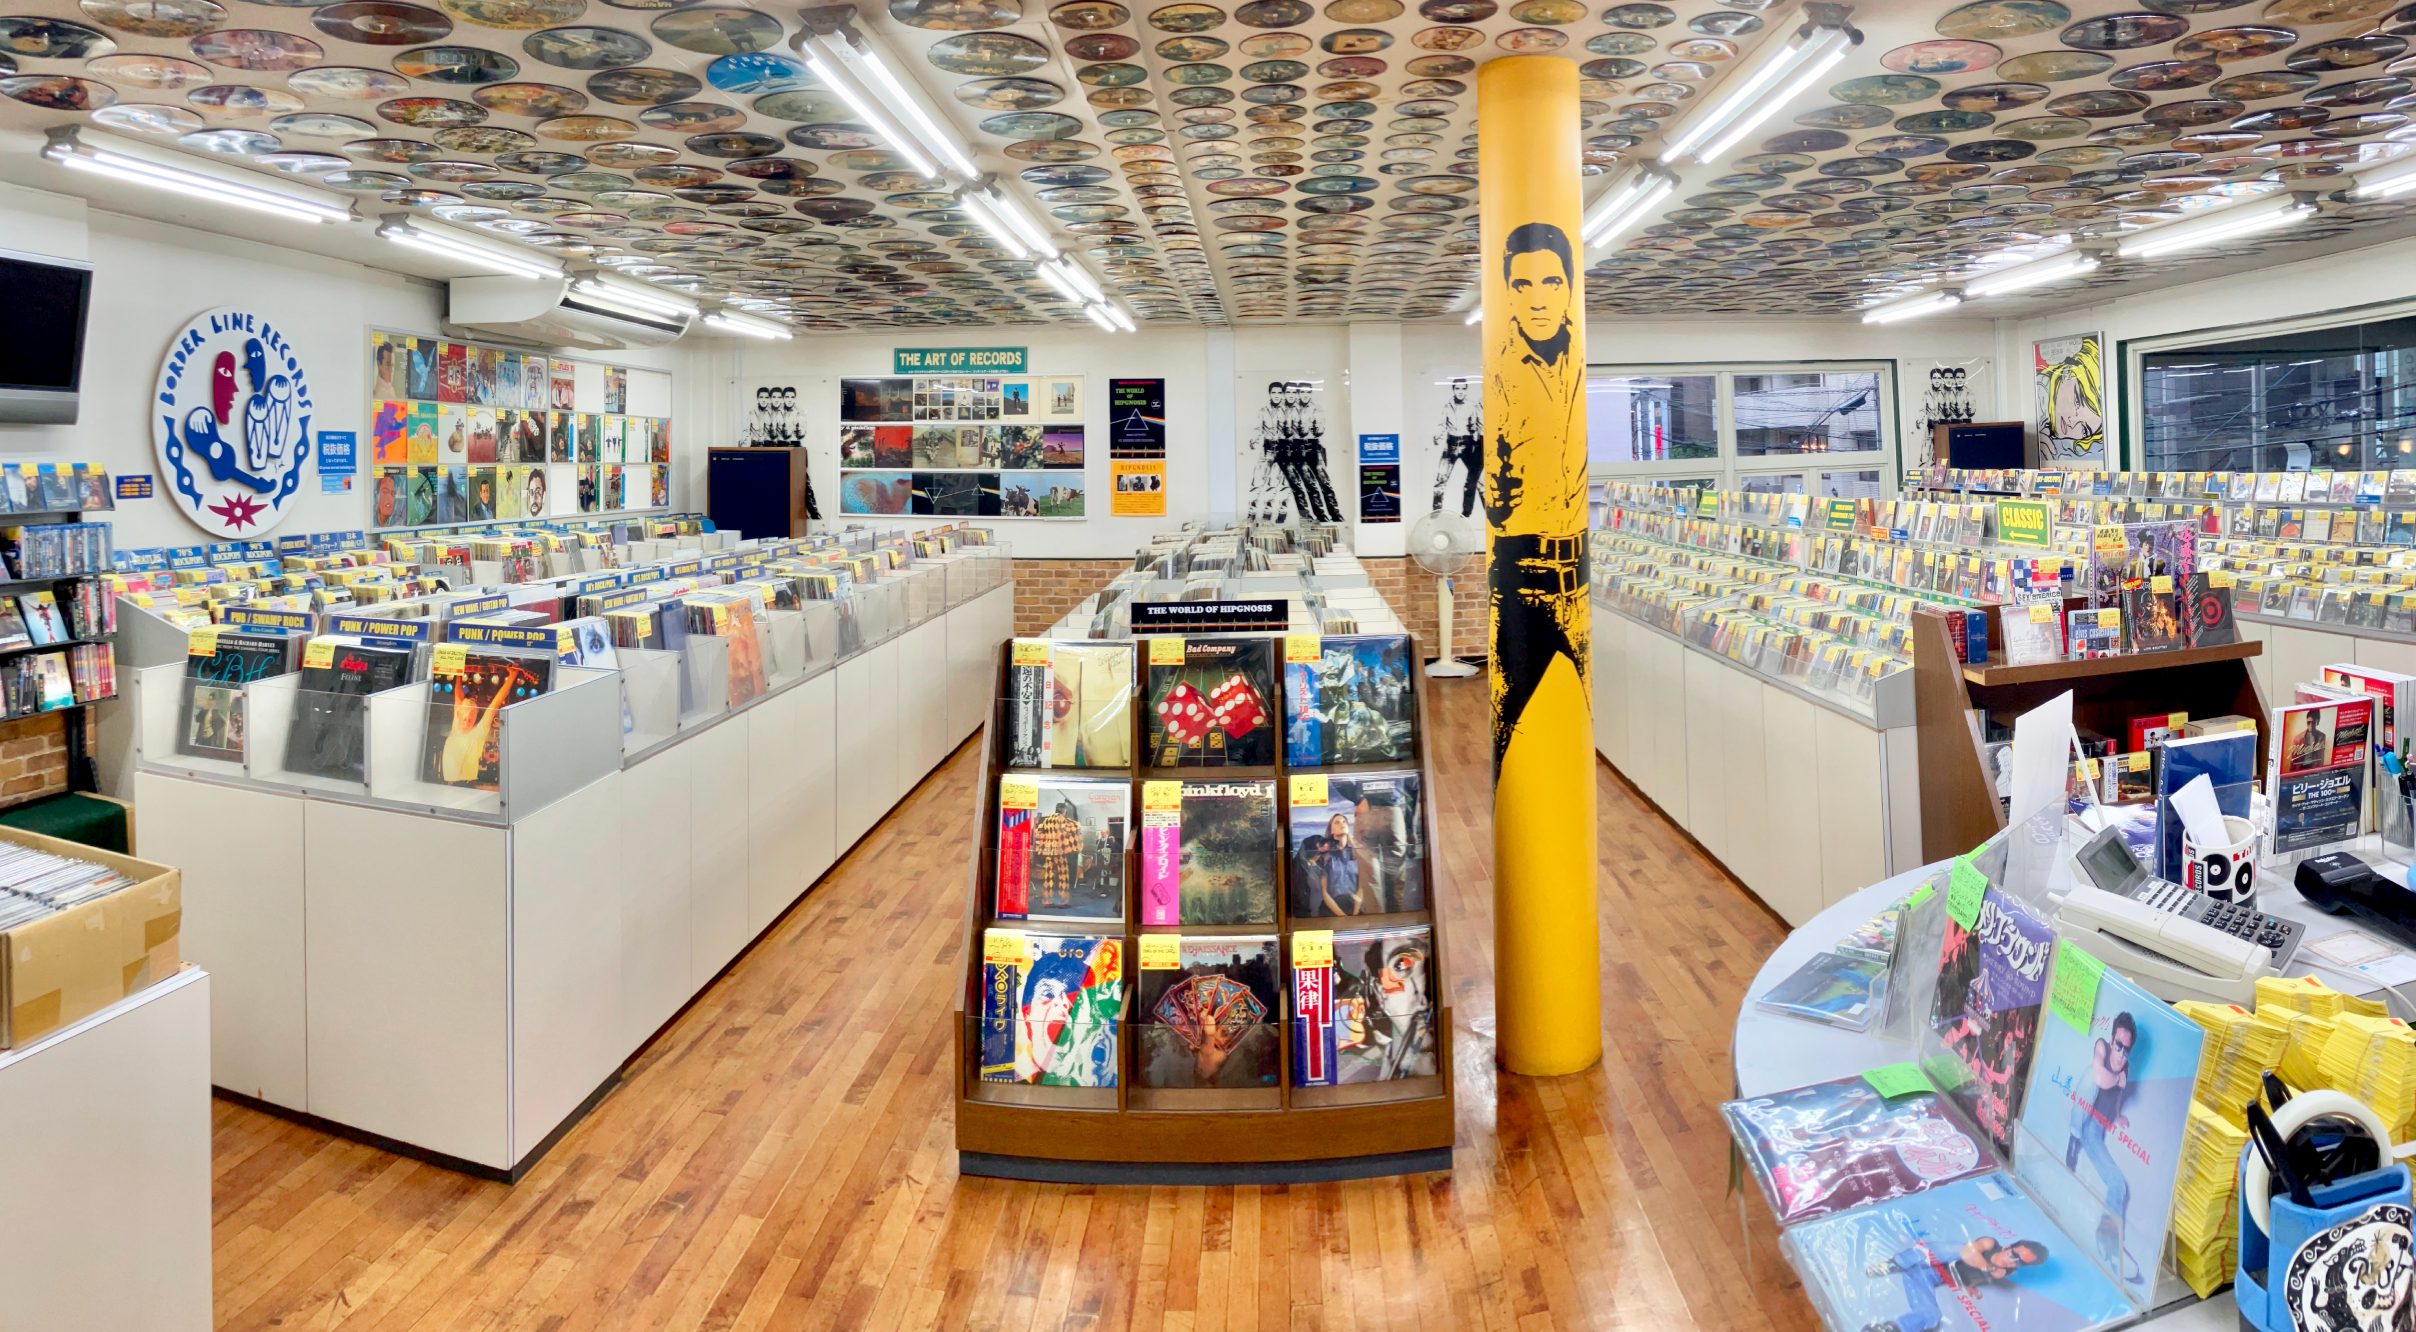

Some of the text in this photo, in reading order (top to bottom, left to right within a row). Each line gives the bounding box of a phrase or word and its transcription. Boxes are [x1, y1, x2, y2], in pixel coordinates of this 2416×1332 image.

[159, 312, 313, 409] BORDER LINE RECORDS
[899, 351, 1022, 366] THE ART OF RECORDS
[2002, 506, 2044, 531] CLASSIC
[453, 606, 465, 616] NEW
[465, 602, 479, 614] WAVE
[482, 599, 499, 611] GUITAR
[499, 598, 508, 608] POP
[1147, 604, 1273, 615] THE WORLD OF HIPGNOSIS
[230, 611, 306, 628] PUB / SWAMP ROCK
[339, 620, 418, 637] PUNK / POWER POP
[458, 627, 546, 642] PUNK / POWER POP
[2075, 628, 2088, 639] elvis
[1185, 644, 1237, 654] Bad Company
[2292, 775, 2352, 796] ビリー・ジョエル
[1088, 791, 1121, 801] Caravan
[2308, 791, 2320, 799] THE
[1057, 948, 1085, 959] UFO
[1182, 945, 1238, 957] RENAISSANCE
[2070, 1090, 2151, 1166] & MIDNIGHT SPECIAL
[1956, 1295, 1992, 1332] SPECIAL
